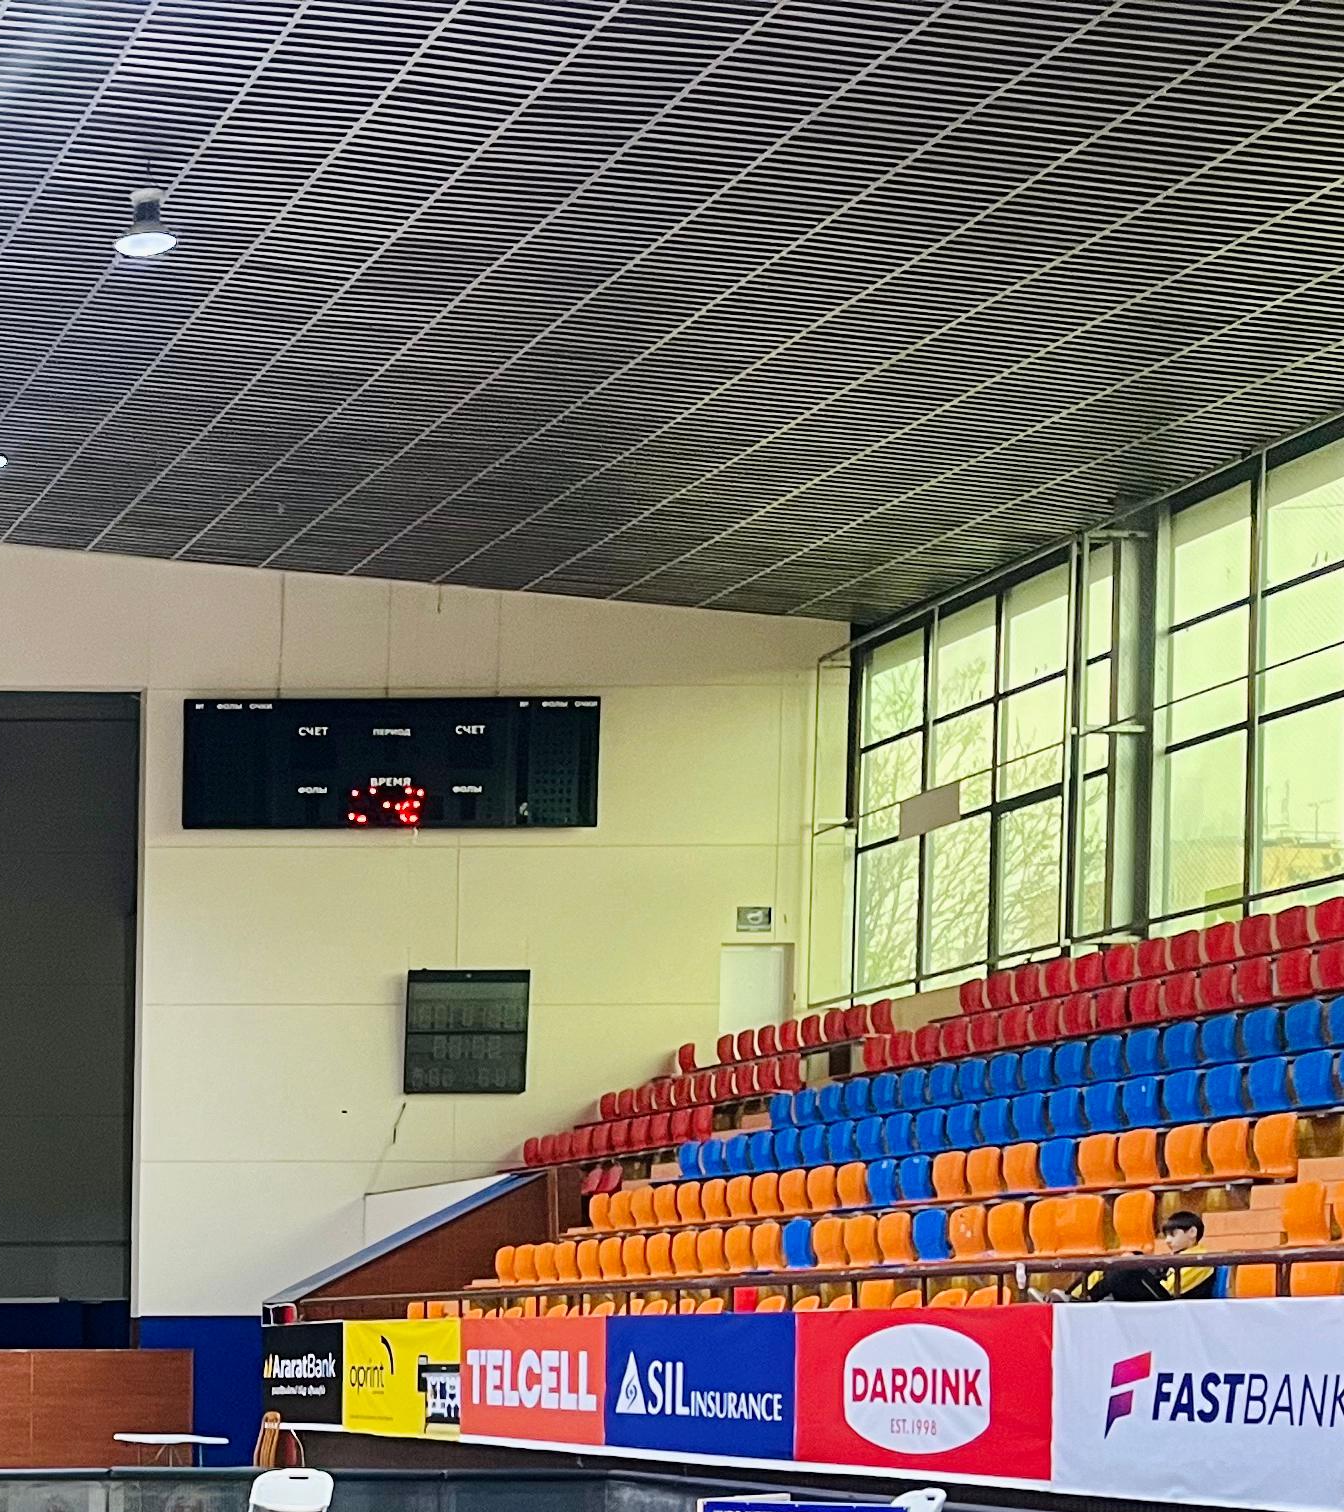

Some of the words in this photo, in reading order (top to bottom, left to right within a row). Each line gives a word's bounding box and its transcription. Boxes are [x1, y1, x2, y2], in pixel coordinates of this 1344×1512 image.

[298, 726, 329, 737] СЧЕТ
[455, 725, 486, 735] СЧЕТ
[369, 777, 412, 787] ВРЕМЯ
[272, 1352, 337, 1379] AraratBank
[466, 1348, 598, 1412] TELCELL
[852, 1367, 983, 1407] DAROINK
[1151, 1373, 1344, 1428] FASTBANK
[690, 1391, 783, 1422] INSURANCE
